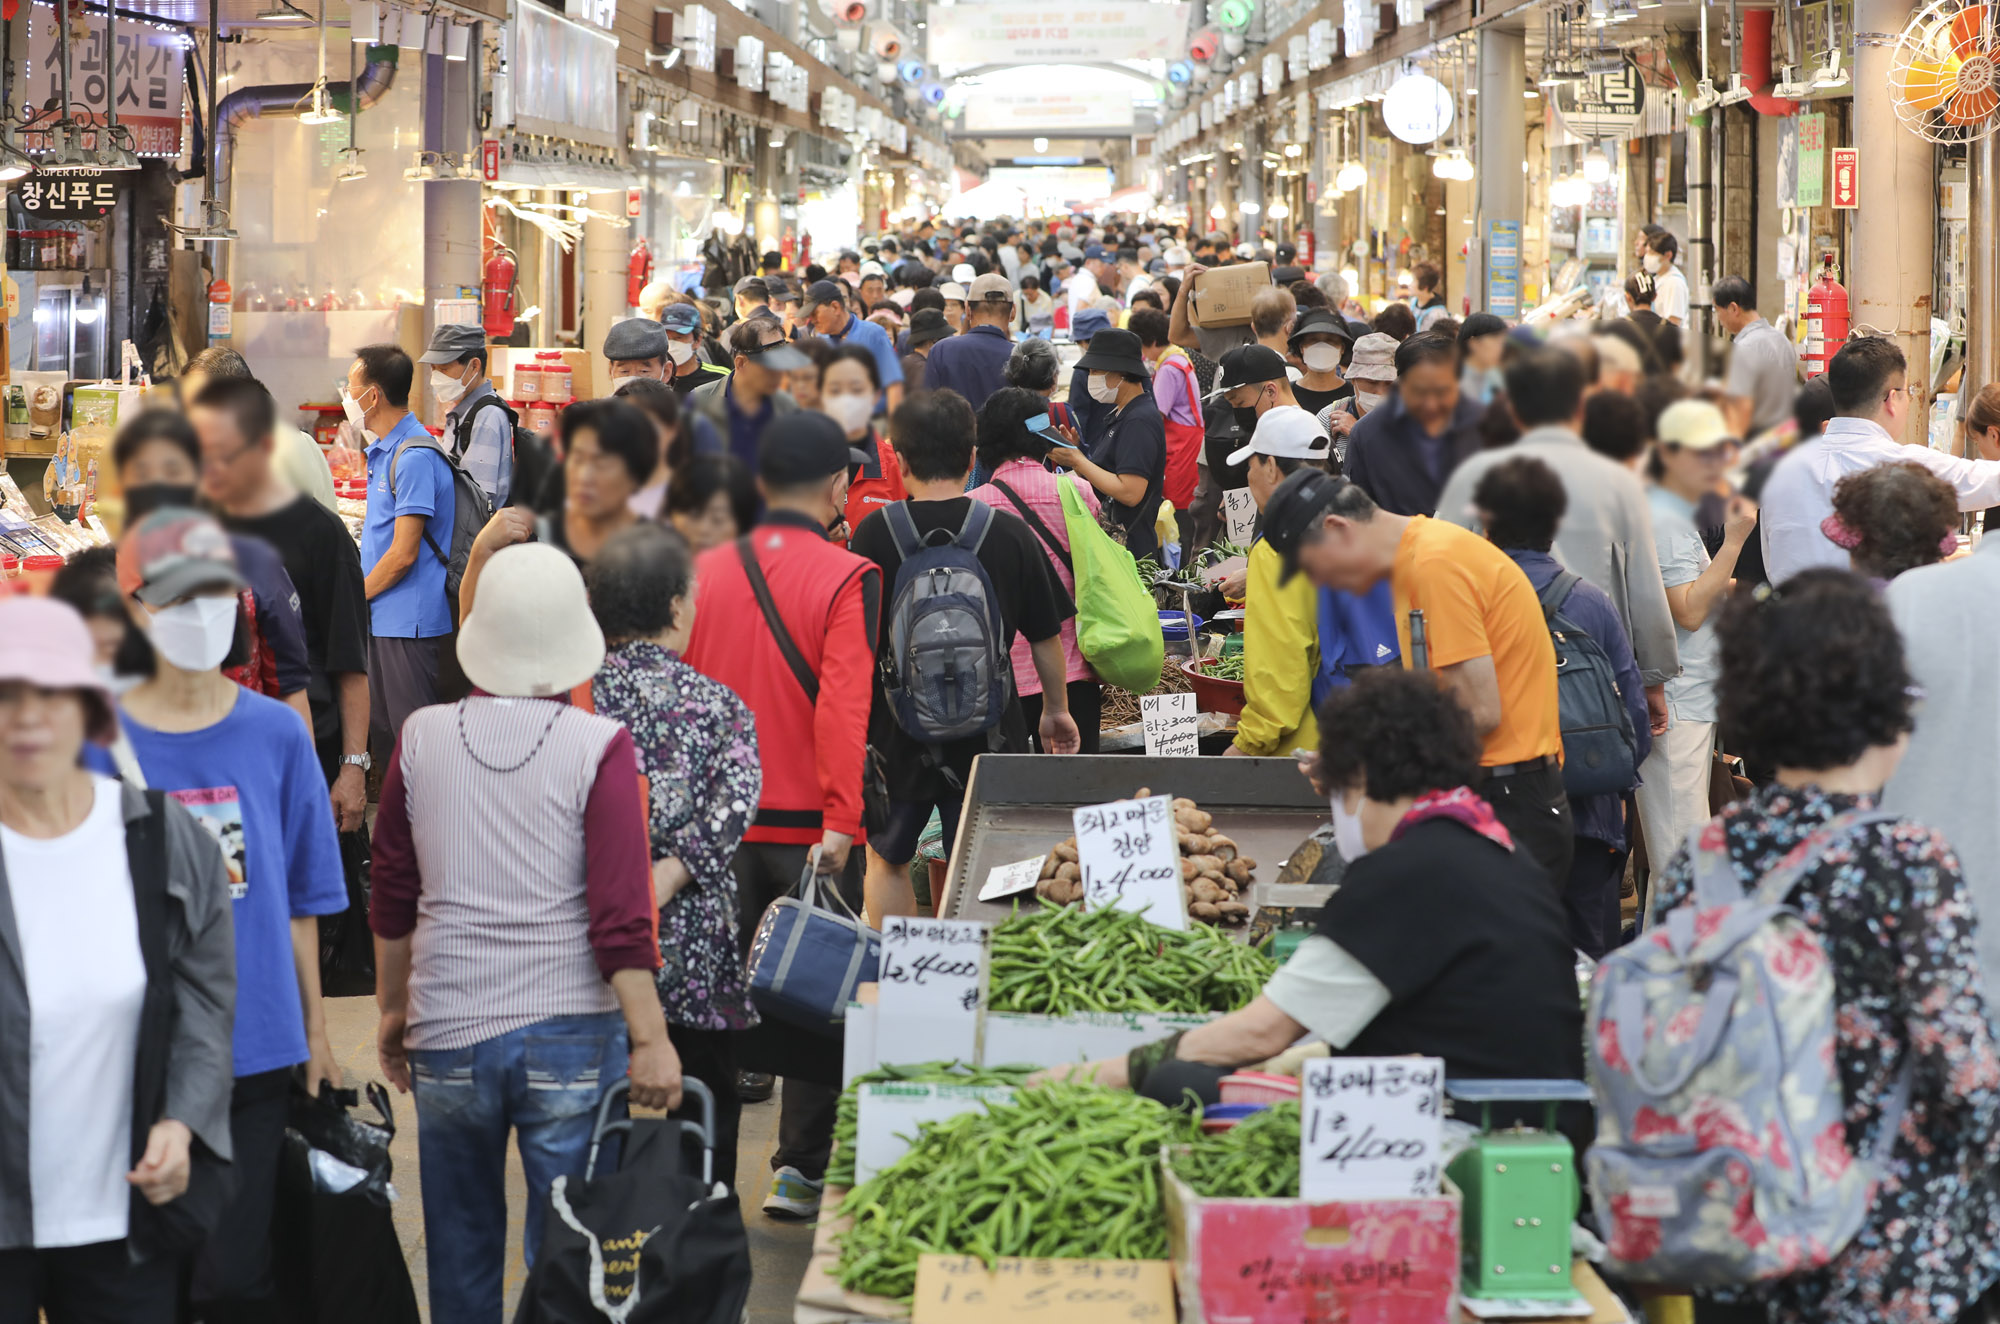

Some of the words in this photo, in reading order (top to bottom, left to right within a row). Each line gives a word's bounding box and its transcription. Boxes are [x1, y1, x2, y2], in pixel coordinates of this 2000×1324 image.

[1836, 154, 1855, 162] 소화기
[36, 168, 69, 177] SUPER
[73, 168, 102, 177] FOOD
[21, 181, 116, 210] 창신푸드
